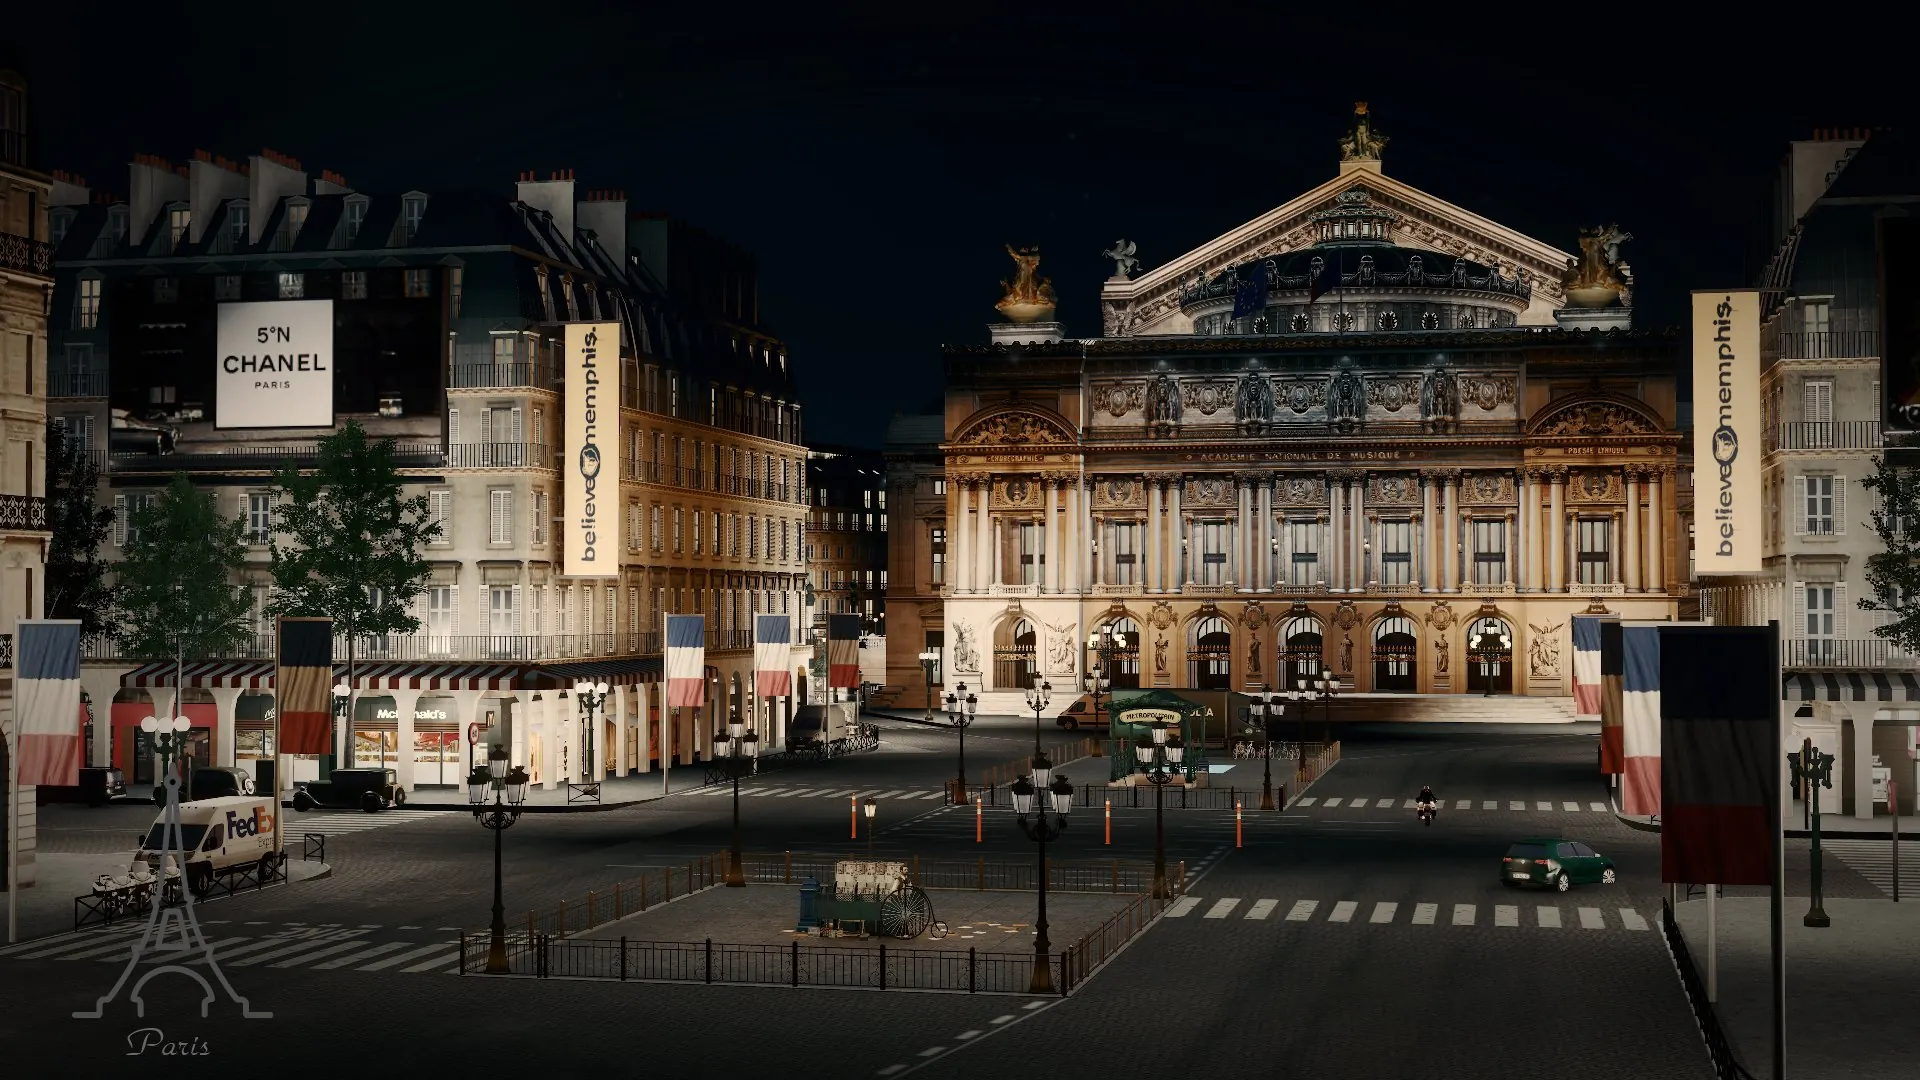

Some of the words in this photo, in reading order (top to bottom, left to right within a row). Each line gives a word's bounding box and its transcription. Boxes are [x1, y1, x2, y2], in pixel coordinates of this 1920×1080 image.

[223, 353, 326, 374] CHANEL
[255, 381, 290, 389] PARIS
[1327, 452, 1341, 460] DE
[1350, 451, 1401, 460] MUSIQUE
[1715, 464, 1734, 557] believe
[581, 479, 596, 562] believe
[376, 708, 447, 720] Mcnald's
